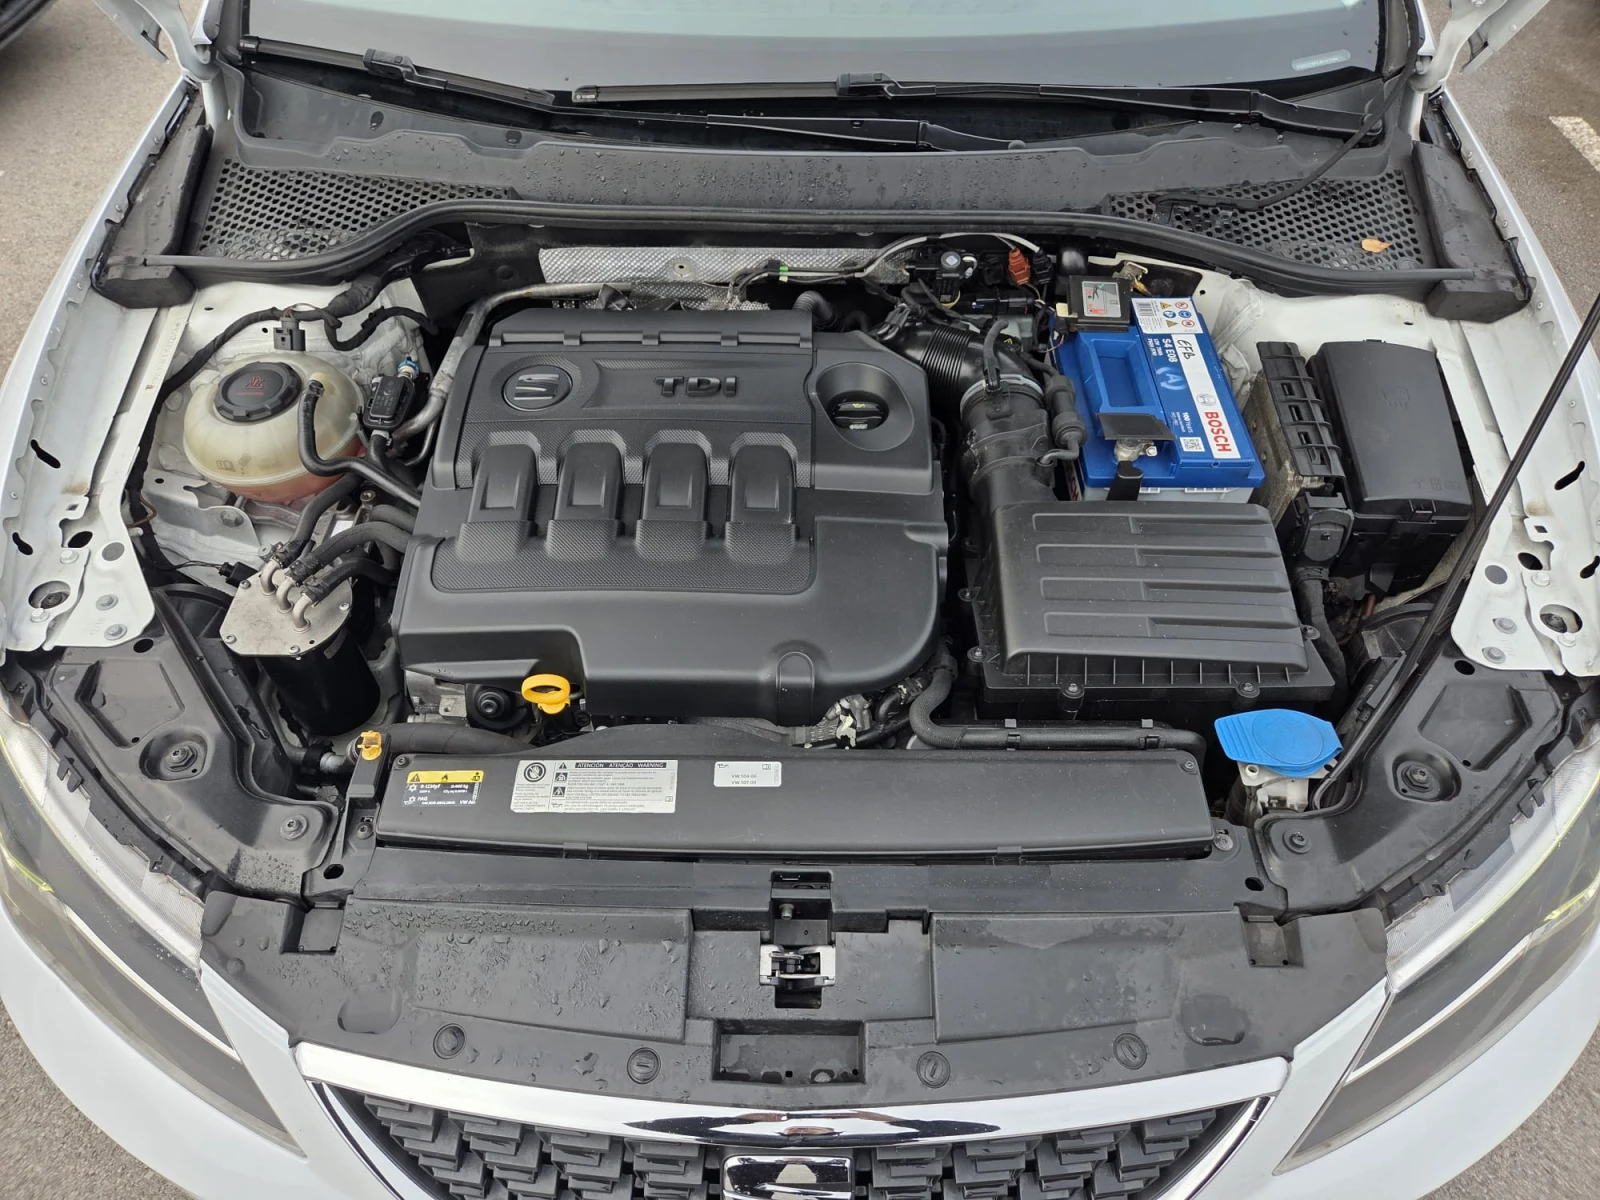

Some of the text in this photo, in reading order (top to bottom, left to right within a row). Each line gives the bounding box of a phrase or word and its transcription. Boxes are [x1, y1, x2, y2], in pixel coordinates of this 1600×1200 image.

[1162, 338, 1178, 362] S4 E08
[1177, 339, 1196, 360] EFB
[654, 376, 738, 398] TDI
[1182, 411, 1191, 421] 100
[1204, 411, 1232, 452] BOSCH
